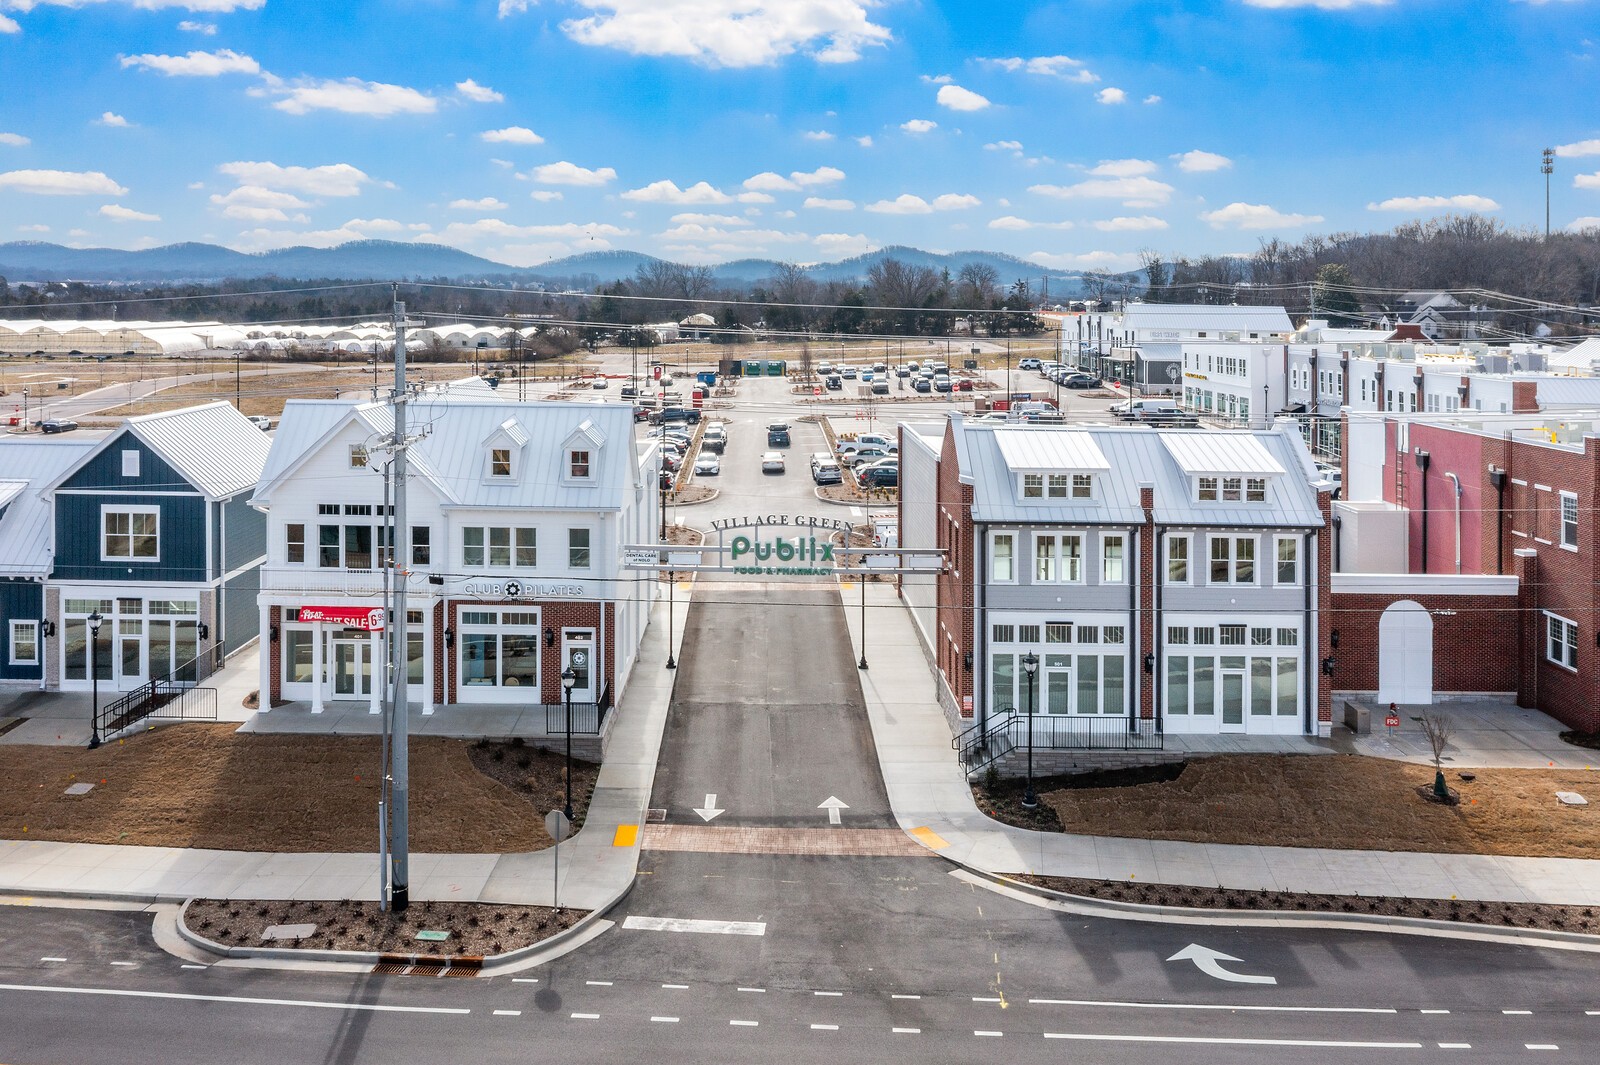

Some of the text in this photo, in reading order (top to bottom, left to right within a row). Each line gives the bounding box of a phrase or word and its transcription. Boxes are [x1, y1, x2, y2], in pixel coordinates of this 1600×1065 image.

[710, 515, 855, 533] VILLAGE GREEN
[731, 536, 835, 561] Publix
[734, 567, 833, 576] FOOD & PHARMACY
[464, 584, 584, 596] CLUB PILATES
[344, 617, 367, 629] SALE
